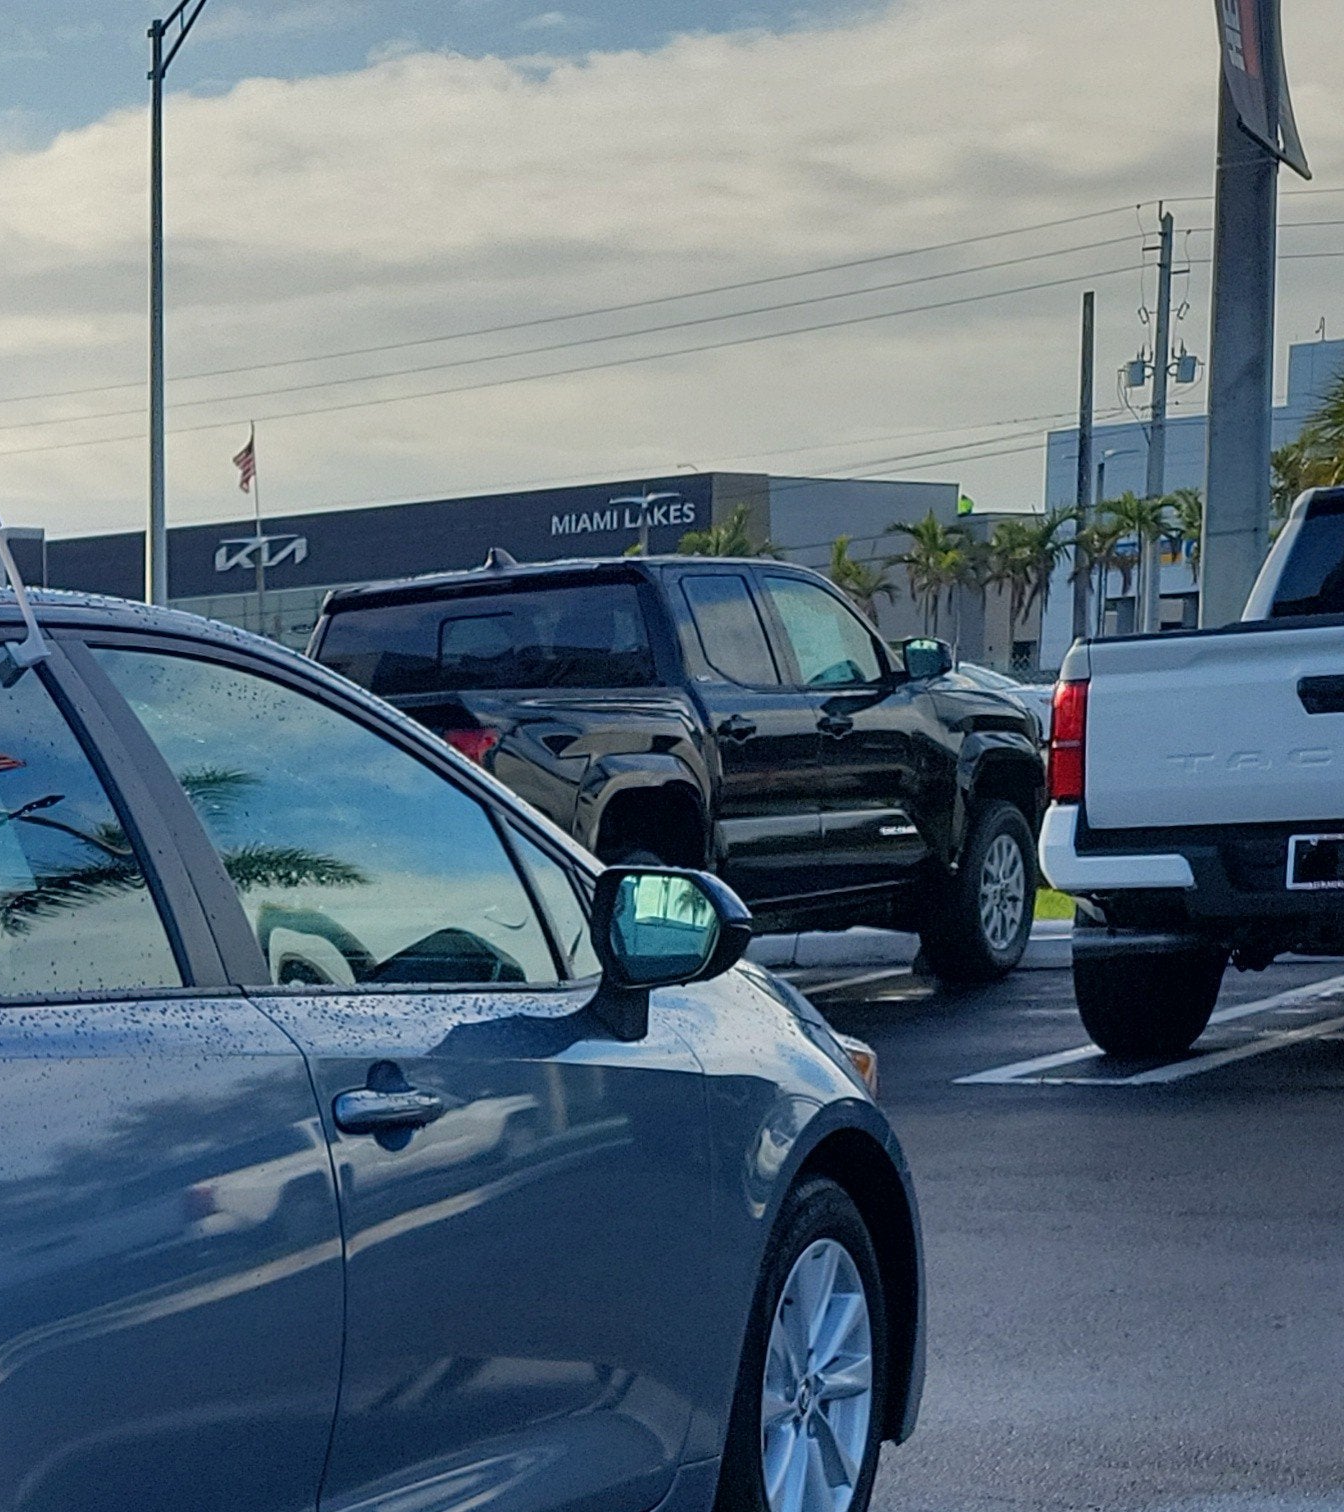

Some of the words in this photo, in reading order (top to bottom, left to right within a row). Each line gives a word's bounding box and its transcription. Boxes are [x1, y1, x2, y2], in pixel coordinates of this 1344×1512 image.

[551, 510, 618, 535] MIAMI
[624, 503, 696, 528] LAKES
[215, 536, 307, 572] KIA
